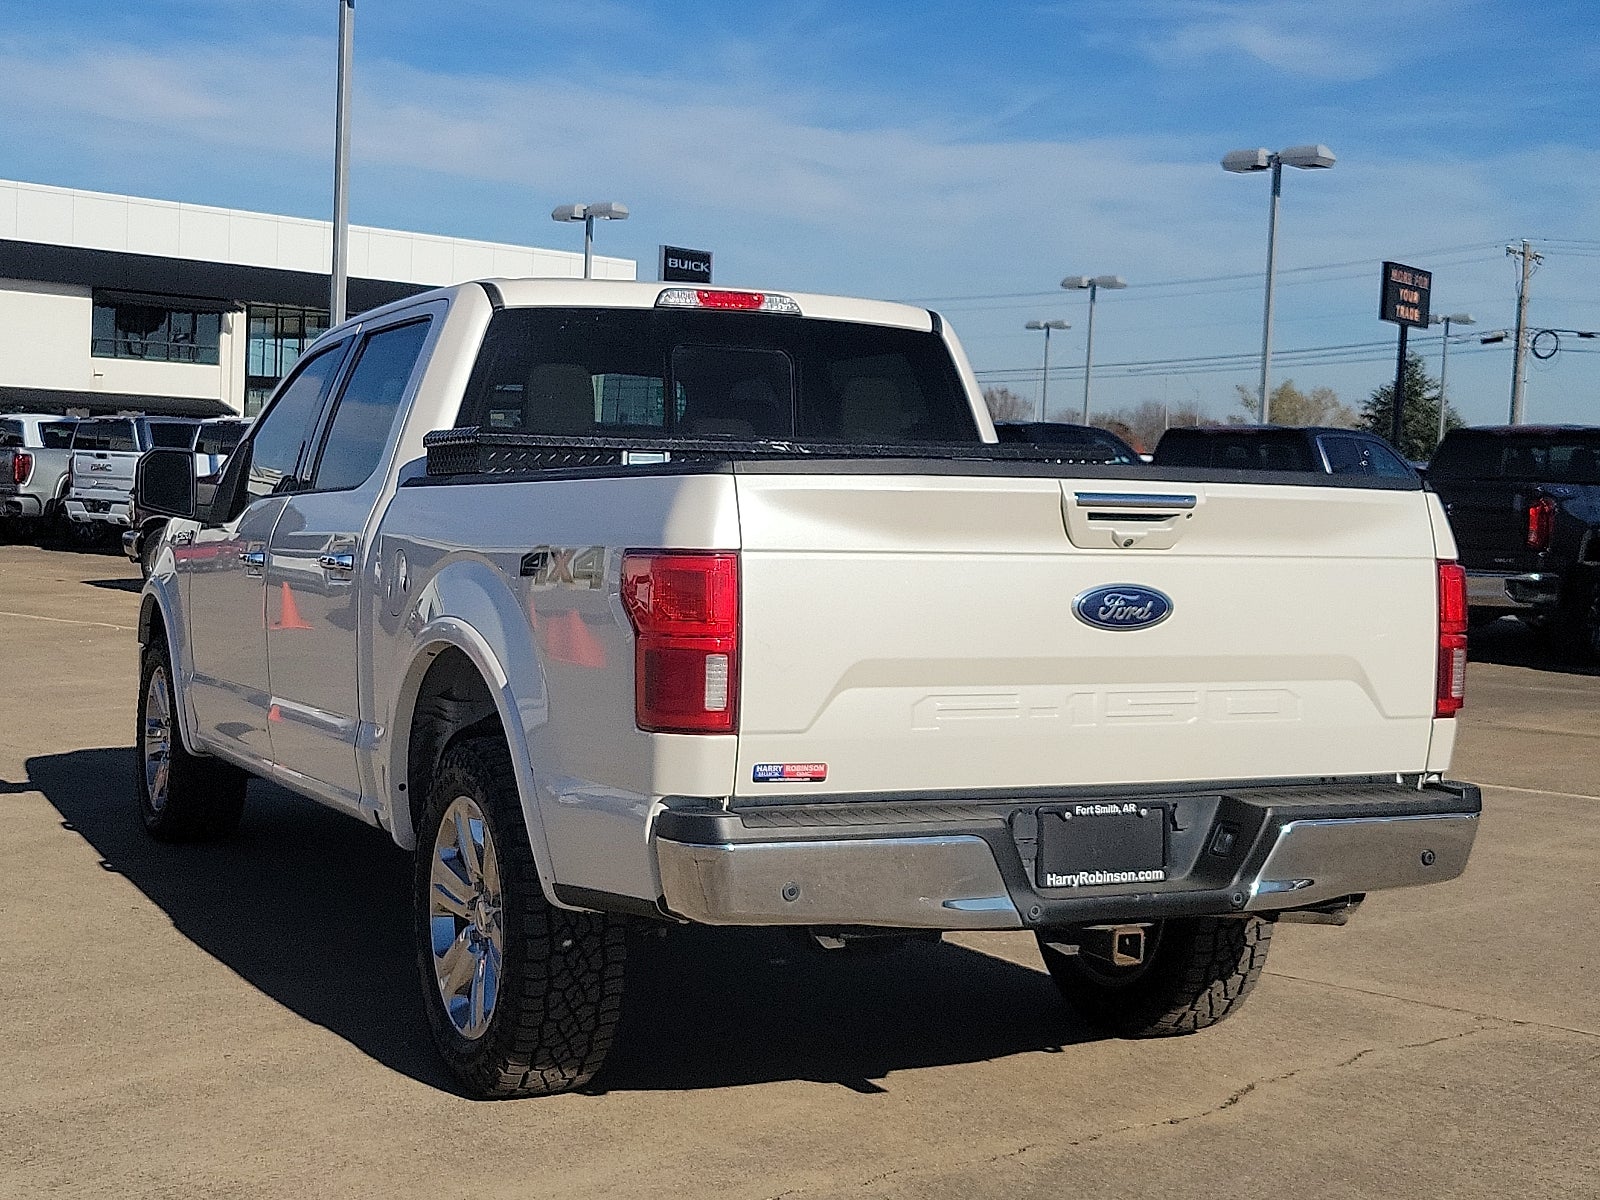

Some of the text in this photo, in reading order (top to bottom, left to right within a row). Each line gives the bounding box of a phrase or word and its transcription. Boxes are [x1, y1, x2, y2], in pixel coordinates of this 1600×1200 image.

[668, 257, 710, 273] BUICK
[1399, 288, 1419, 304] YOUR
[1396, 304, 1420, 321] TRADE
[1098, 593, 1153, 620] Ford
[911, 688, 1301, 731] F-150
[756, 764, 825, 772] HARRY ROBINSON
[1075, 803, 1137, 816] Fort Smith, AR
[1046, 869, 1165, 887] HarryRobinson.com
